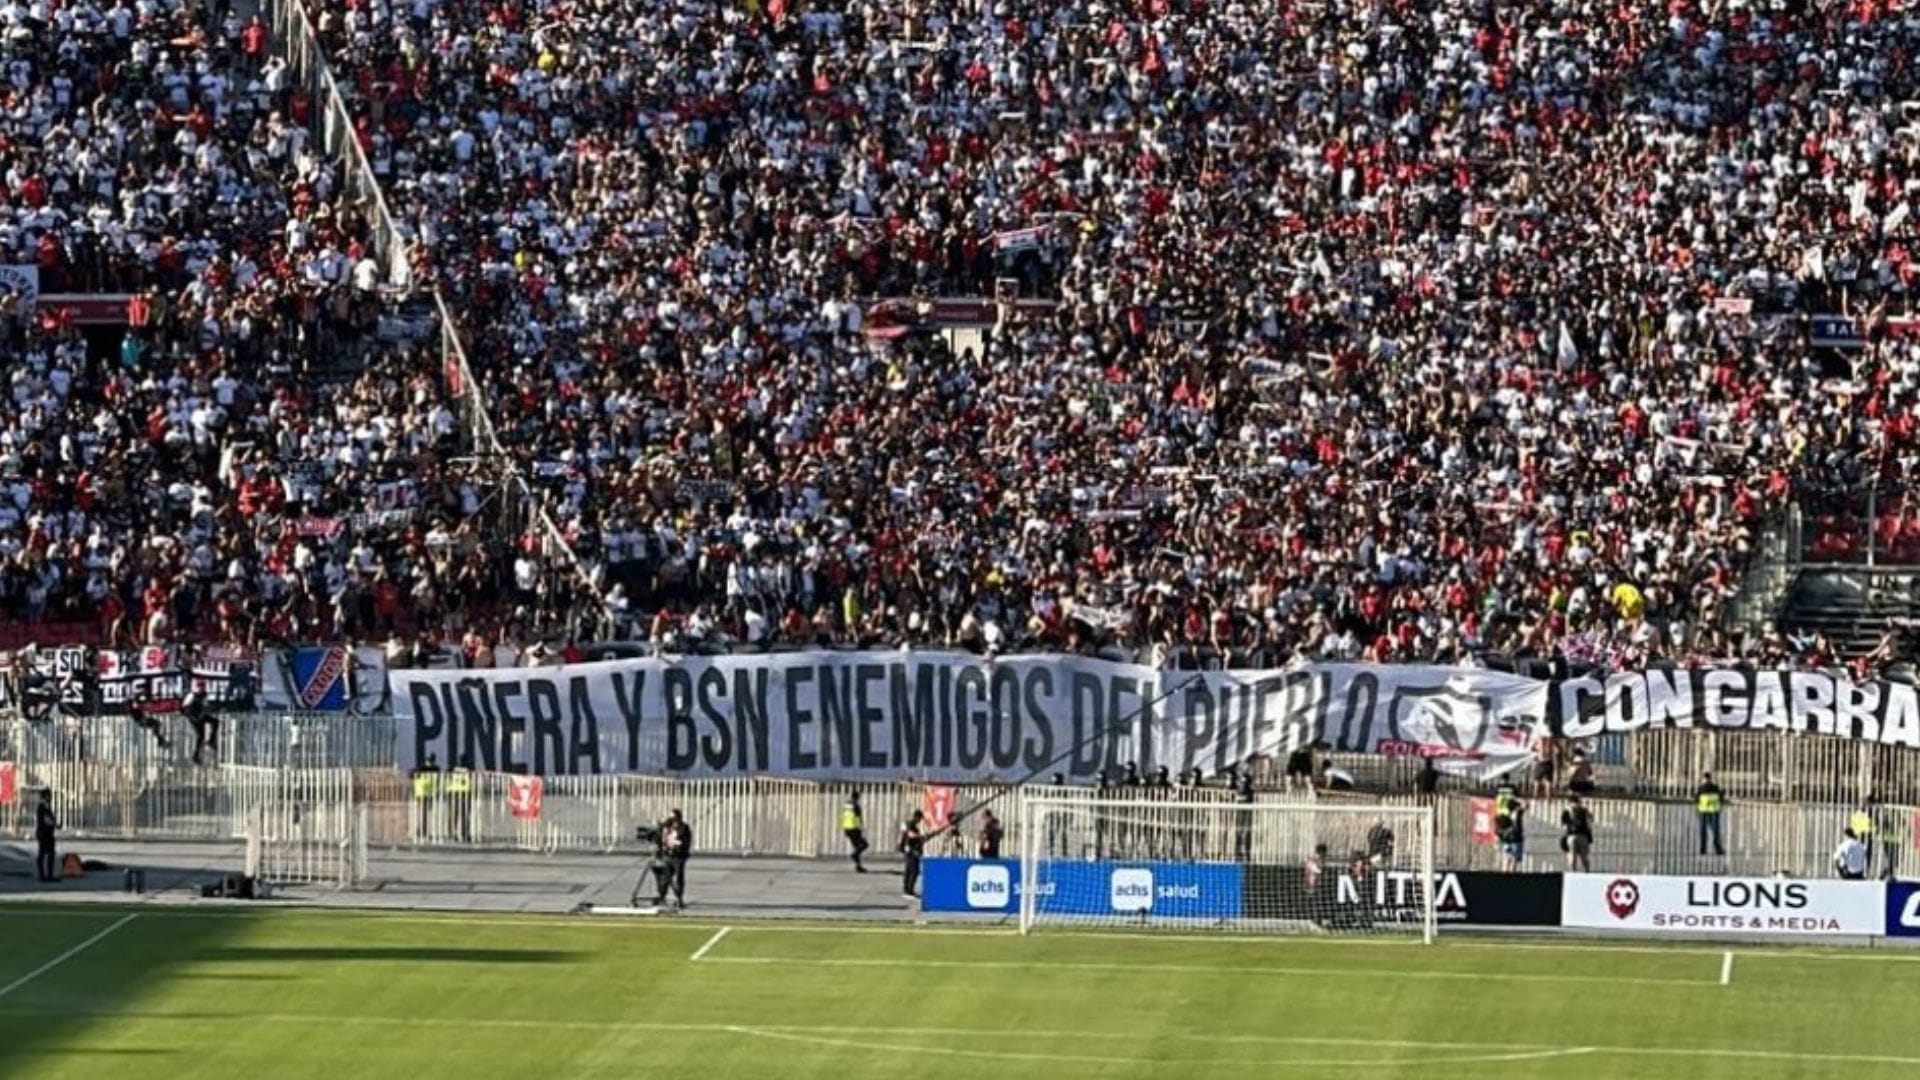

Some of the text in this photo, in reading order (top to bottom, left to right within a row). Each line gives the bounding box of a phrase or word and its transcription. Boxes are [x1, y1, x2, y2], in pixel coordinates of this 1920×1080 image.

[410, 676, 600, 775] PIÑERA
[611, 670, 645, 770] Y
[664, 667, 769, 771] BSN
[785, 663, 1053, 770] ENEMIGOS
[1560, 670, 1920, 748] CON GARRA
[971, 879, 1055, 896] achs sud
[1115, 883, 1199, 900] achs salud
[1687, 881, 1809, 908] LIONS
[1653, 912, 1841, 931] SPORTS & MEDIA
